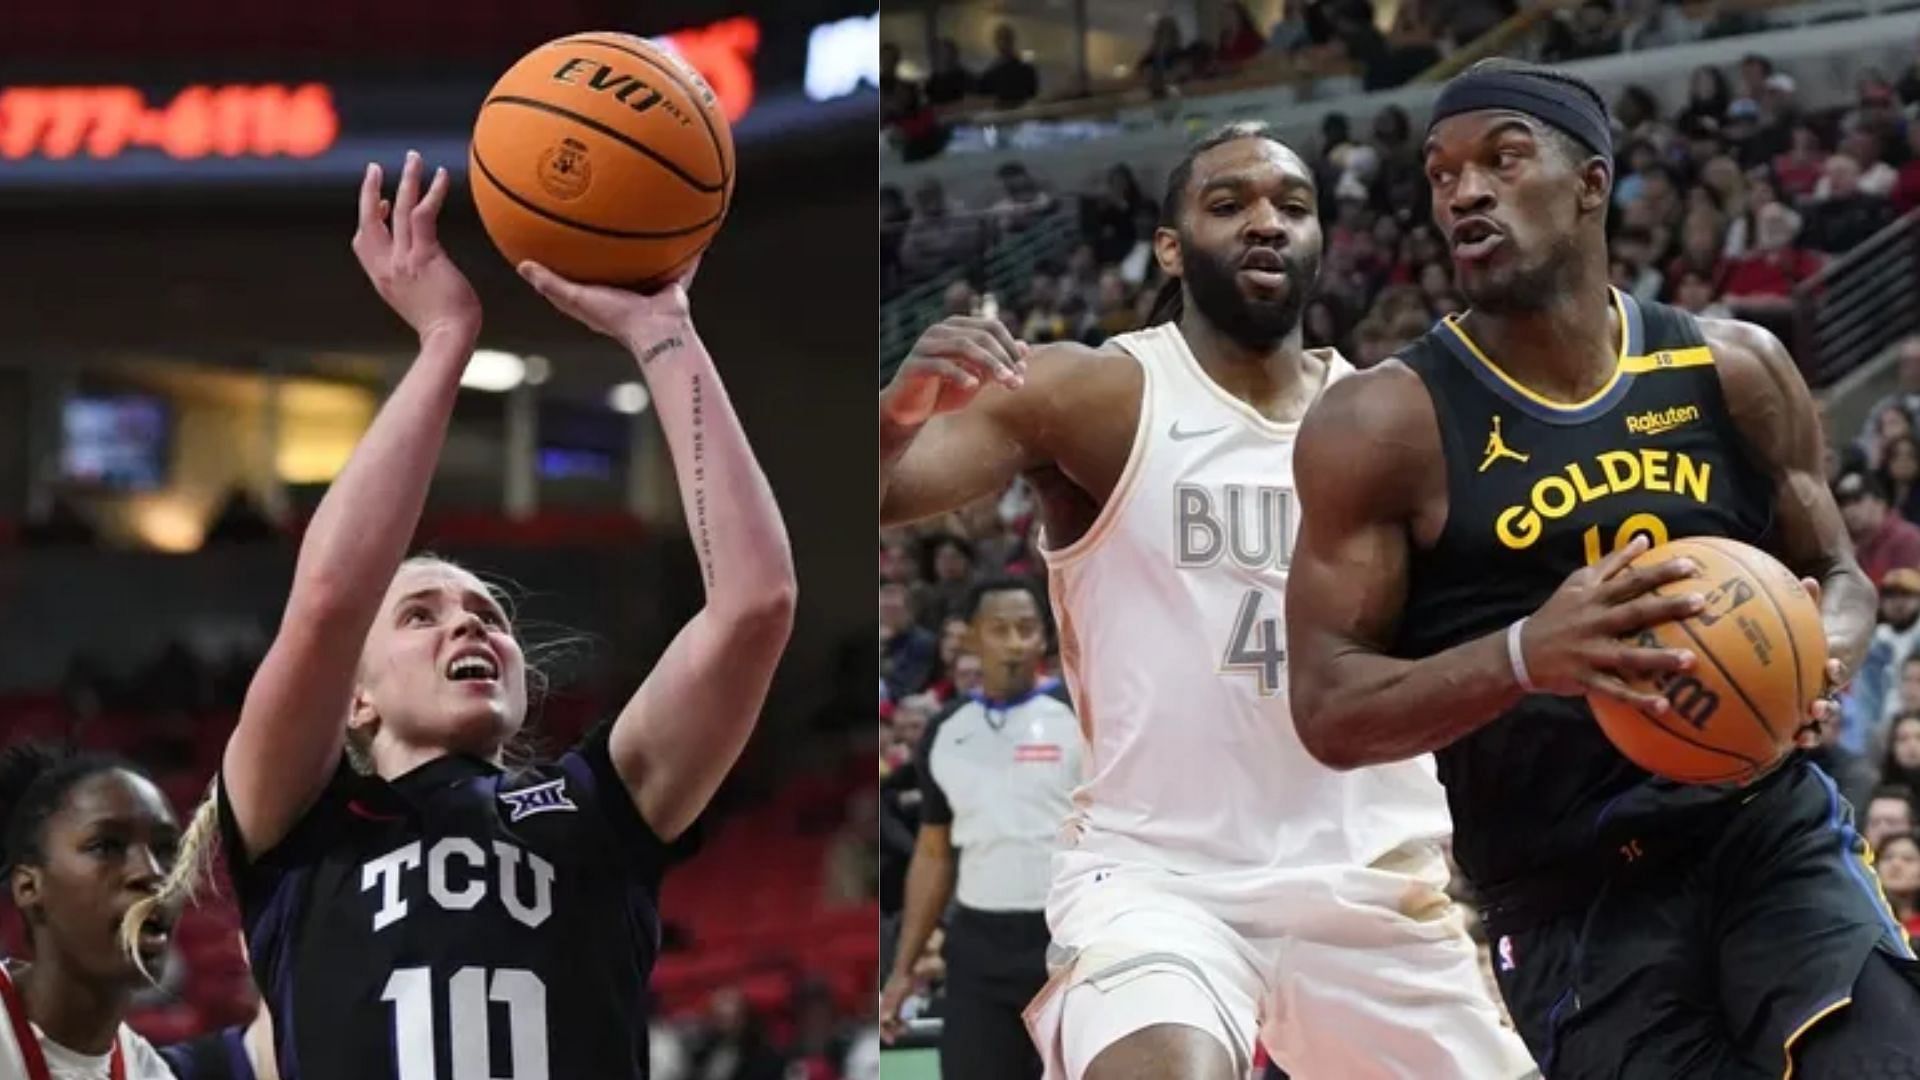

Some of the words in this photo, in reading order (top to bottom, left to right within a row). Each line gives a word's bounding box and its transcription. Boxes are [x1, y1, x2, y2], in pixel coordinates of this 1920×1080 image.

[553, 57, 662, 113] EVO
[692, 373, 703, 426] DREAM
[1626, 405, 1700, 434] Rakuten
[1496, 449, 1711, 549] GOLDEN
[1215, 588, 1287, 697] 4
[361, 837, 555, 933] TCU
[380, 965, 549, 1080] 10
